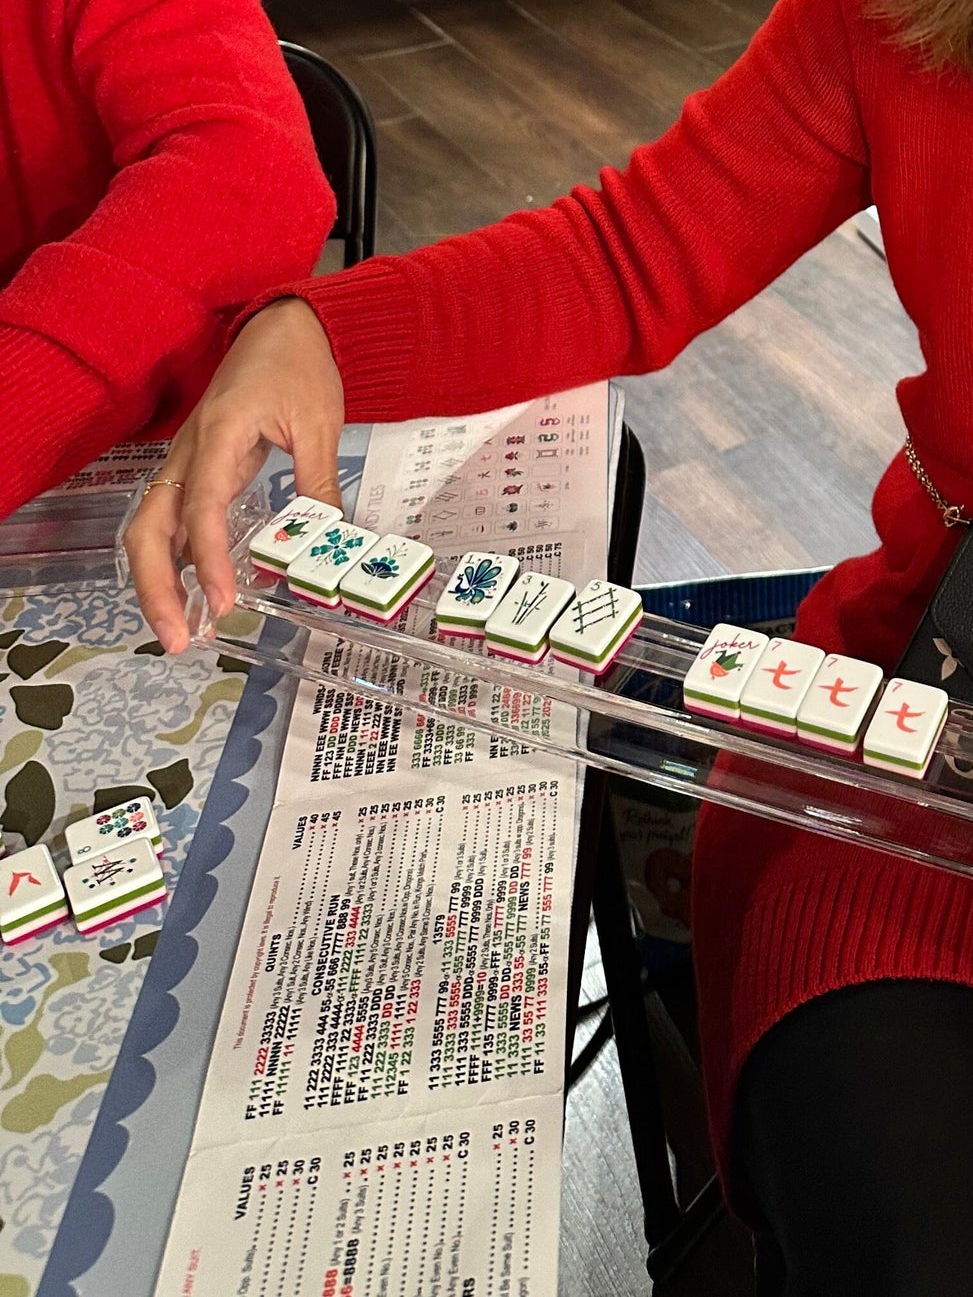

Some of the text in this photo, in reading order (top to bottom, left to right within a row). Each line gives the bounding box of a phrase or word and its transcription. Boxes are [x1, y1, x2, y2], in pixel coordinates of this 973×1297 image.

[269, 504, 329, 526] joker
[518, 547, 525, 556] 50
[527, 546, 534, 554] 50
[536, 545, 544, 553] 50
[545, 544, 553, 552] 50
[521, 575, 533, 586] 3
[589, 582, 601, 591] 5
[700, 633, 761, 660] joker
[772, 640, 783, 651] 7
[827, 657, 838, 668] 7
[892, 681, 903, 693] 7
[319, 711, 331, 734] WWW
[316, 735, 327, 752] EEE
[321, 692, 345, 781] FF 123 DD DDD DDDD
[332, 708, 353, 780] FFF NN EE WWW
[310, 754, 323, 782] NNNN
[539, 781, 548, 791] 30
[437, 796, 445, 805] 30
[265, 816, 308, 972] QUINTS VALUES
[269, 881, 279, 904] reproduce
[263, 911, 274, 924] illegal
[432, 915, 445, 945] 13579
[311, 895, 340, 996] CONSECUTIVE RUN
[344, 802, 401, 1104] FFF 123 4444 5555 25
[384, 798, 434, 1097] 112345 1111 1111 30
[245, 814, 319, 1120] FF 111 2222 33333 40
[254, 948, 265, 971] copyright
[259, 813, 330, 1117] 11111 NNNN 22222 45
[272, 811, 342, 1116] FF 11111 11 11111 45
[525, 968, 536, 993] 9999
[246, 980, 257, 1004] protected
[409, 979, 421, 999] 333
[407, 1001, 418, 1015] 22
[524, 996, 534, 1009] 77
[237, 1011, 249, 1037] document
[523, 1011, 533, 1025] 55
[403, 1027, 415, 1048] 333
[522, 1028, 533, 1043] 33
[233, 1038, 243, 1050] This
[401, 1051, 412, 1065] 22
[521, 1047, 532, 1075] 1111
[397, 1080, 409, 1095] FF
[492, 1124, 503, 1139] 25
[509, 1121, 520, 1135] 30
[524, 1120, 535, 1145] C 30
[393, 1142, 405, 1158] 25
[410, 1140, 421, 1156] 25
[426, 1137, 437, 1153] 25
[442, 1135, 454, 1150] 25
[458, 1132, 470, 1159] C 30
[343, 1152, 355, 1168] 25
[360, 1149, 372, 1164] 25
[377, 1145, 389, 1161] 25
[259, 1164, 272, 1180] 25
[276, 1160, 289, 1176] 25
[293, 1160, 305, 1175] 30
[307, 1157, 321, 1185] C 30
[235, 1167, 255, 1220] VALUES
